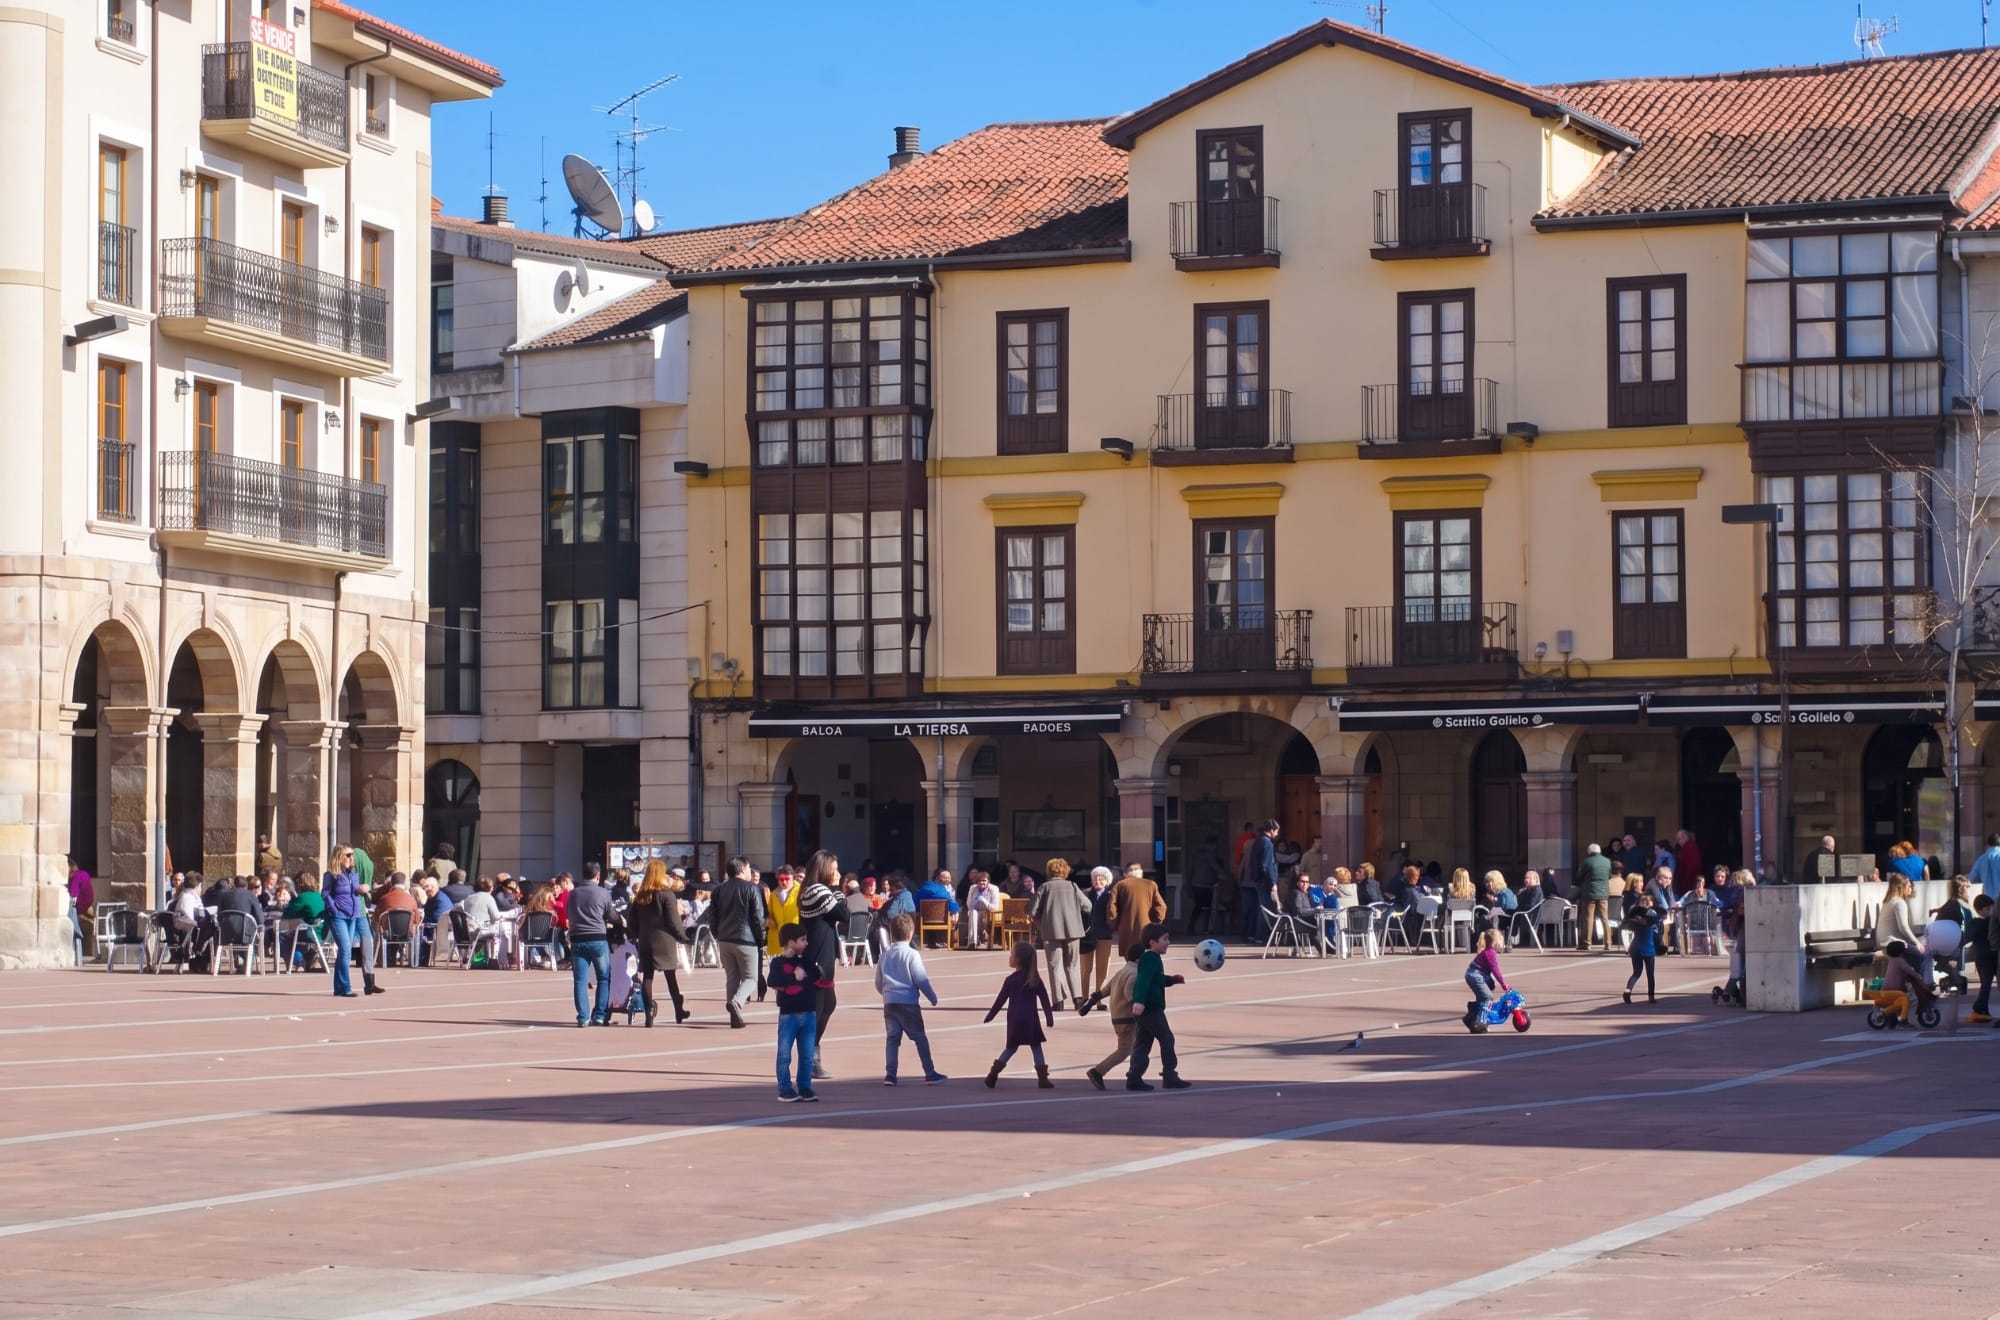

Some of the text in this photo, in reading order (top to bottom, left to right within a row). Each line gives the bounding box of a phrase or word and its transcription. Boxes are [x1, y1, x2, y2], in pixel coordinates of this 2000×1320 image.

[251, 19, 294, 55] SE VENDE
[802, 726, 842, 736] BALOA
[894, 723, 969, 736] LA TIERSA
